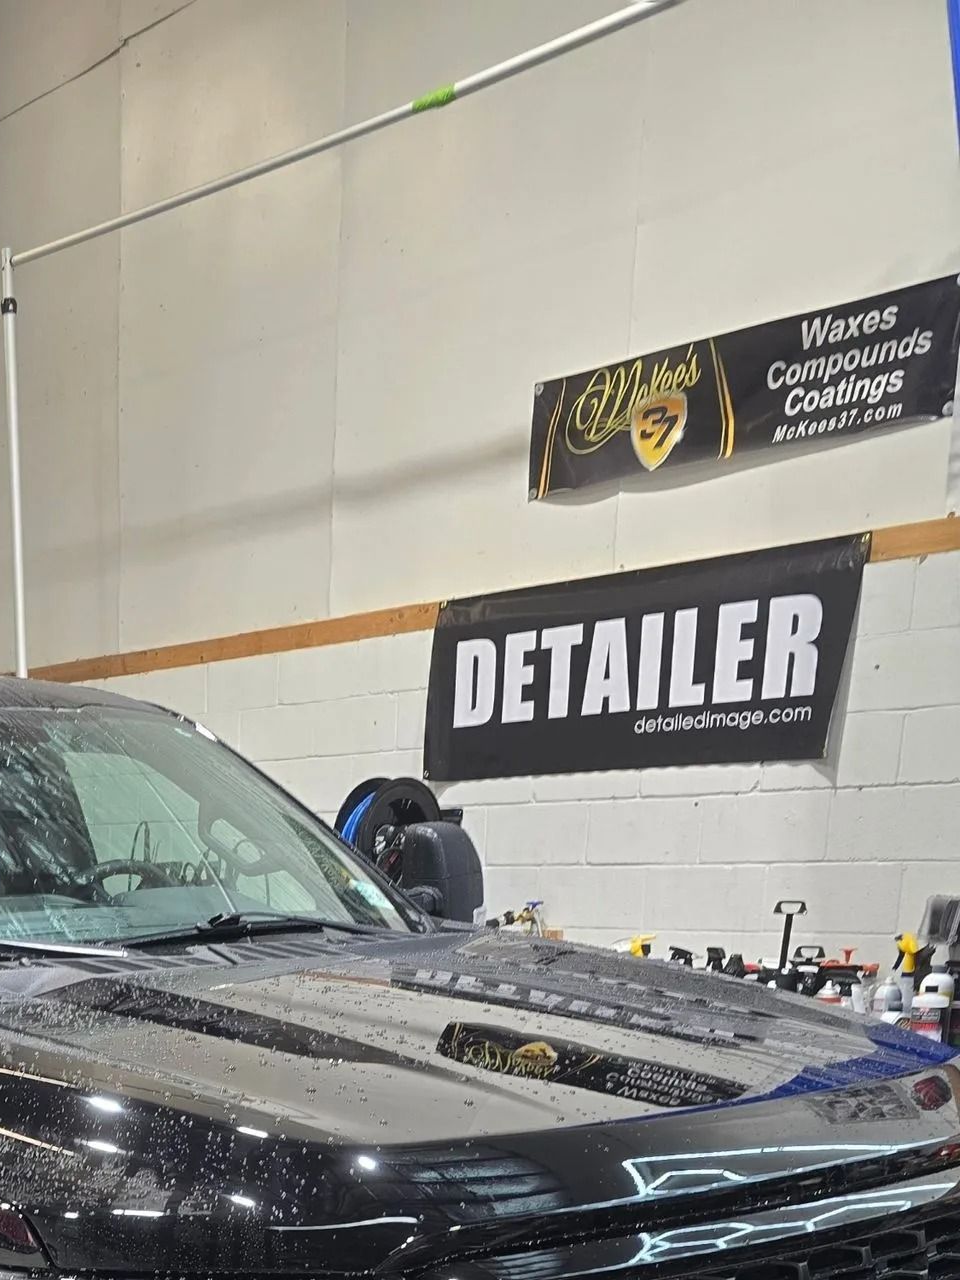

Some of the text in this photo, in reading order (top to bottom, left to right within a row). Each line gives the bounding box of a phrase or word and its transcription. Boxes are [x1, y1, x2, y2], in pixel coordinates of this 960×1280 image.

[801, 304, 898, 350] Waxes
[767, 327, 933, 390] Compounds
[784, 369, 905, 416] Coatings
[641, 406, 679, 450] 37
[772, 403, 902, 443] McKees37.com
[453, 594, 823, 728] DETAILER
